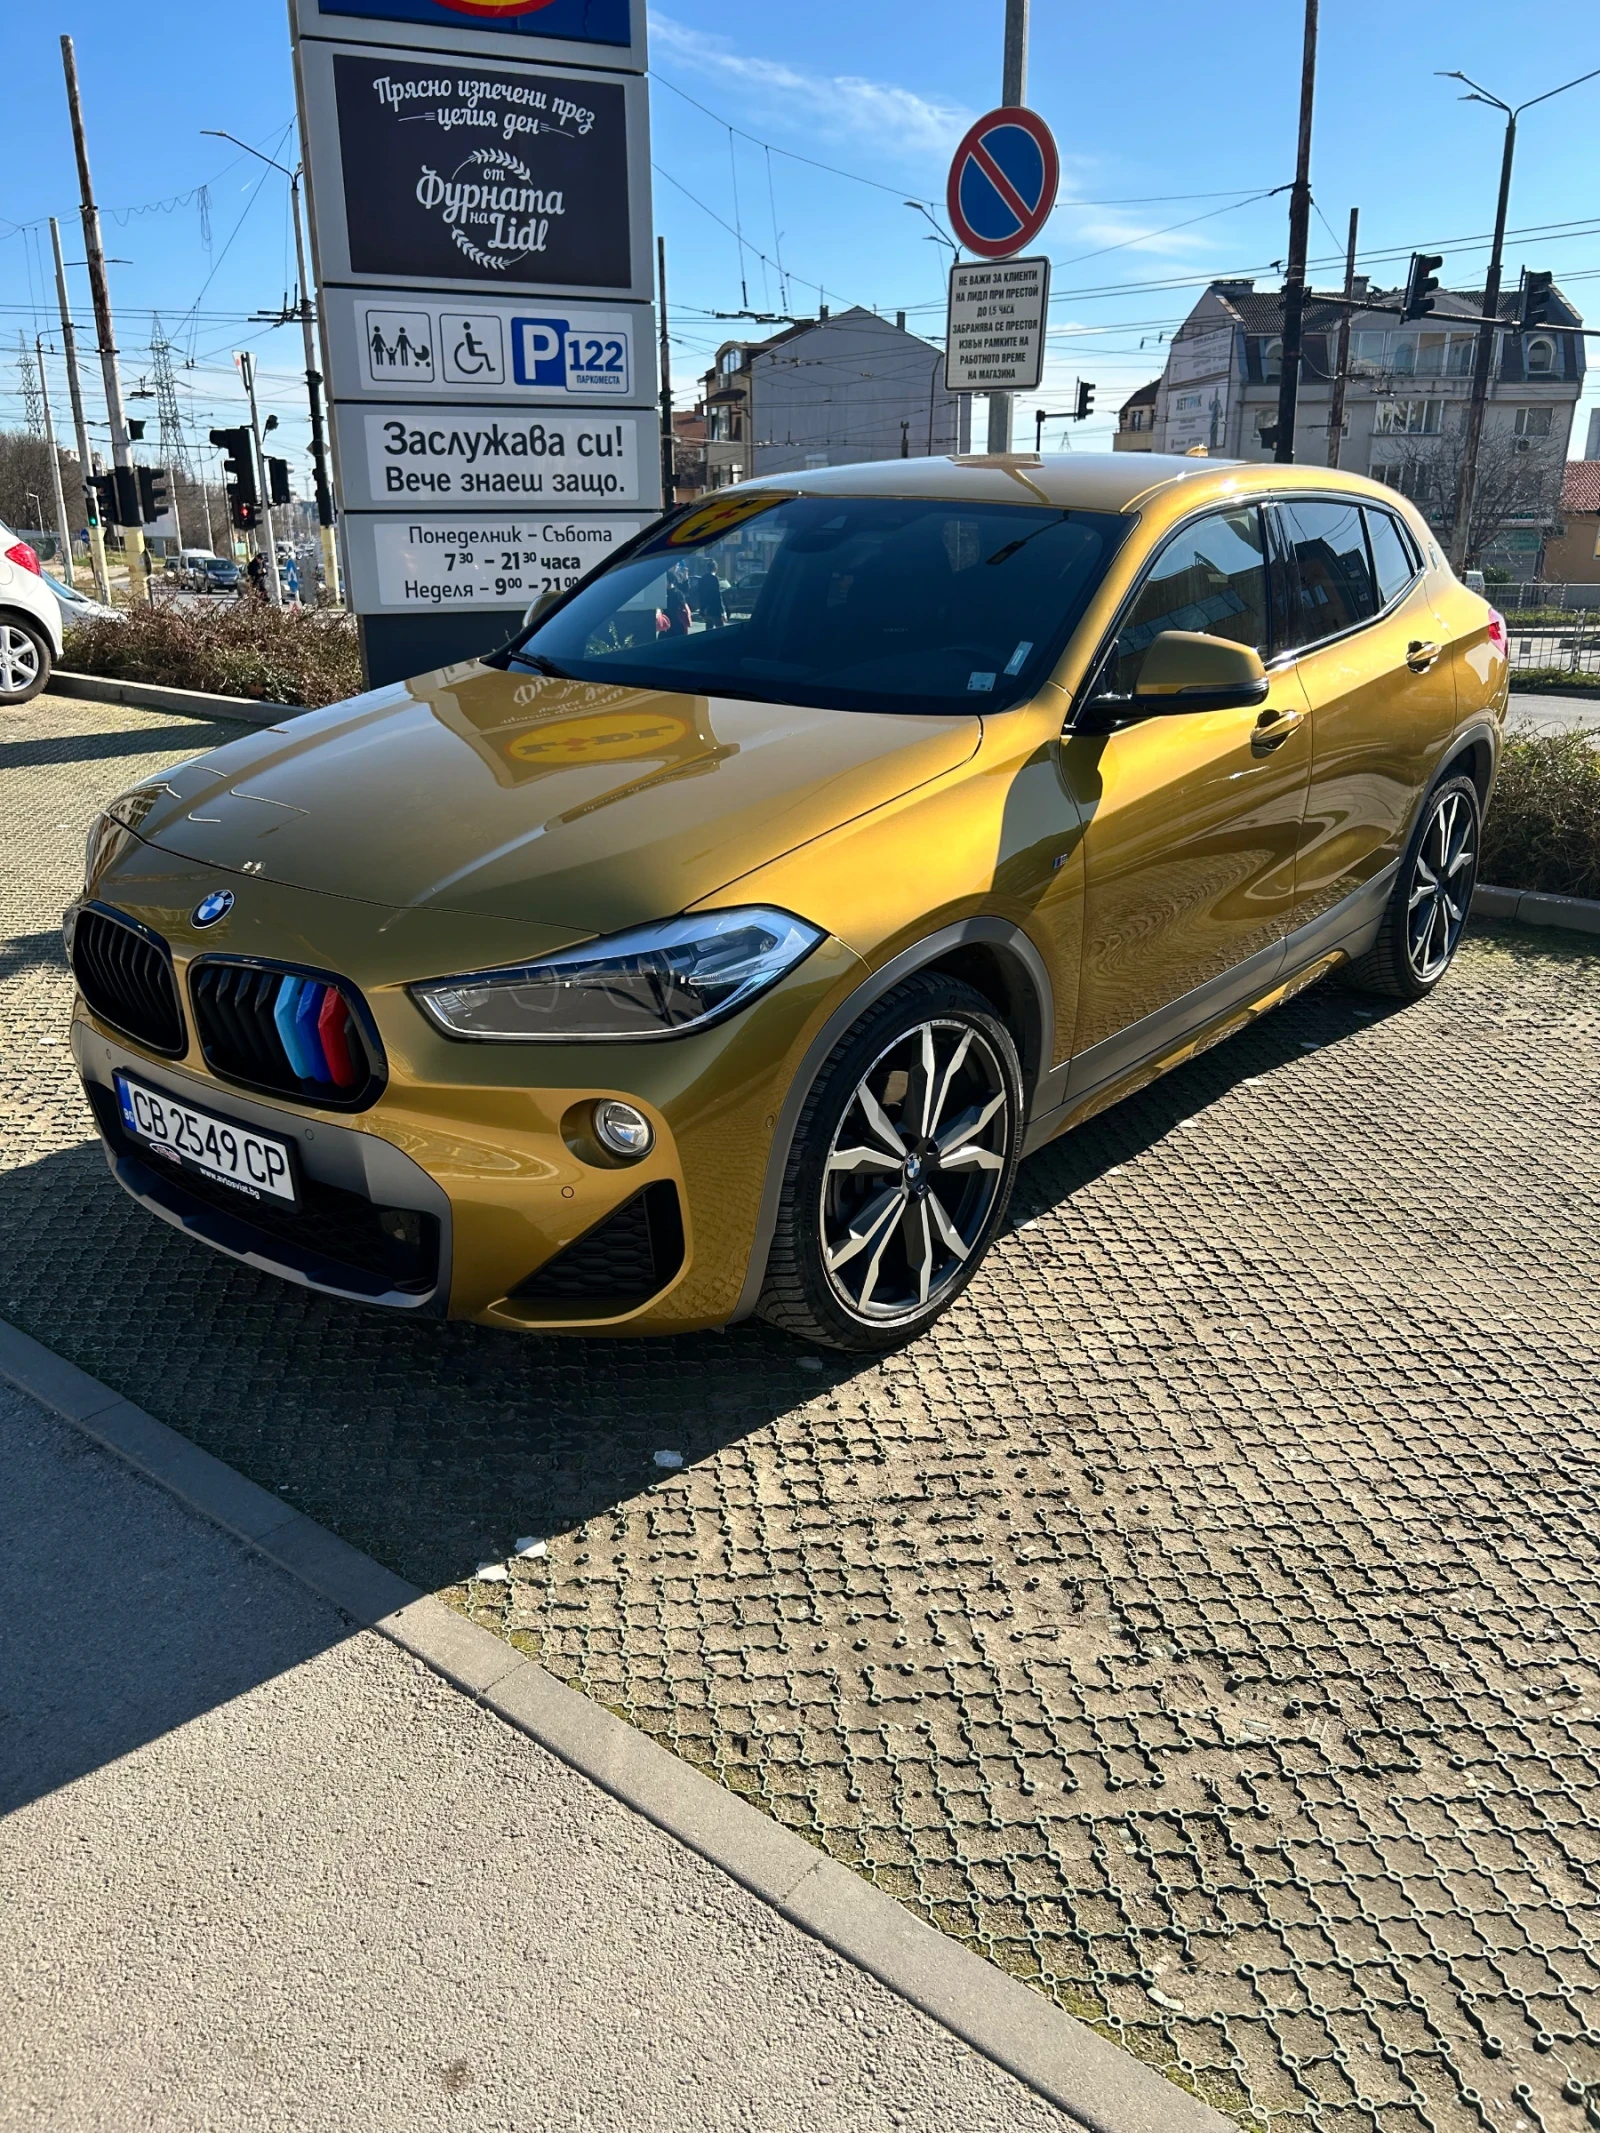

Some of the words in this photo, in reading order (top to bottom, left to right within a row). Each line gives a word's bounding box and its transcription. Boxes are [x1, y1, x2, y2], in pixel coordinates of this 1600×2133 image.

[372, 76, 452, 112] Прясно
[458, 80, 547, 109] изпечени
[551, 97, 595, 135] през
[437, 107, 498, 131] целия
[502, 112, 540, 139] ден
[483, 168, 505, 182] от
[416, 165, 565, 224] Фурната
[470, 211, 489, 225] на
[488, 212, 549, 252] Lidl
[959, 276, 967, 286] НЕ
[969, 274, 991, 285] ВАЖИ
[993, 273, 1002, 283] ЗА
[1004, 271, 1037, 283] КЛИЕНТИ
[956, 292, 965, 302] НА
[967, 290, 987, 302] ЛИДЛ
[989, 289, 1004, 300] ПРИ
[1006, 284, 1039, 298] ПРЕСТОЙ
[977, 306, 987, 318] ДО
[999, 305, 1015, 315] ЧАСА
[952, 322, 993, 334] ЗАБРАНЯВА
[995, 321, 1004, 332] СЕ
[1006, 319, 1038, 331] ПРЕСТОЯ
[959, 338, 982, 349] ИЗВЪН
[984, 337, 1018, 348] РАМКИТЕ
[1019, 336, 1029, 346] НА
[522, 324, 560, 380] P
[568, 340, 624, 372] 122
[960, 353, 1000, 365] РАБОТНОТО
[1001, 352, 1026, 363] ВРЕМЕ
[576, 374, 621, 386] ПАРКОМЕСТА
[968, 370, 977, 380] НА
[978, 369, 1016, 380] МАГАЗИНА
[383, 421, 566, 463] Заслужава
[577, 426, 623, 457] си!
[385, 466, 451, 493] Вече
[460, 473, 543, 492] знаеш
[552, 473, 625, 497] защо.
[409, 525, 523, 549] Понеделник
[542, 525, 613, 543] Събота
[541, 556, 581, 570] часа
[405, 580, 473, 603] Неделя
[123, 1107, 135, 1122] BG
[170, 1108, 238, 1172] 2549
